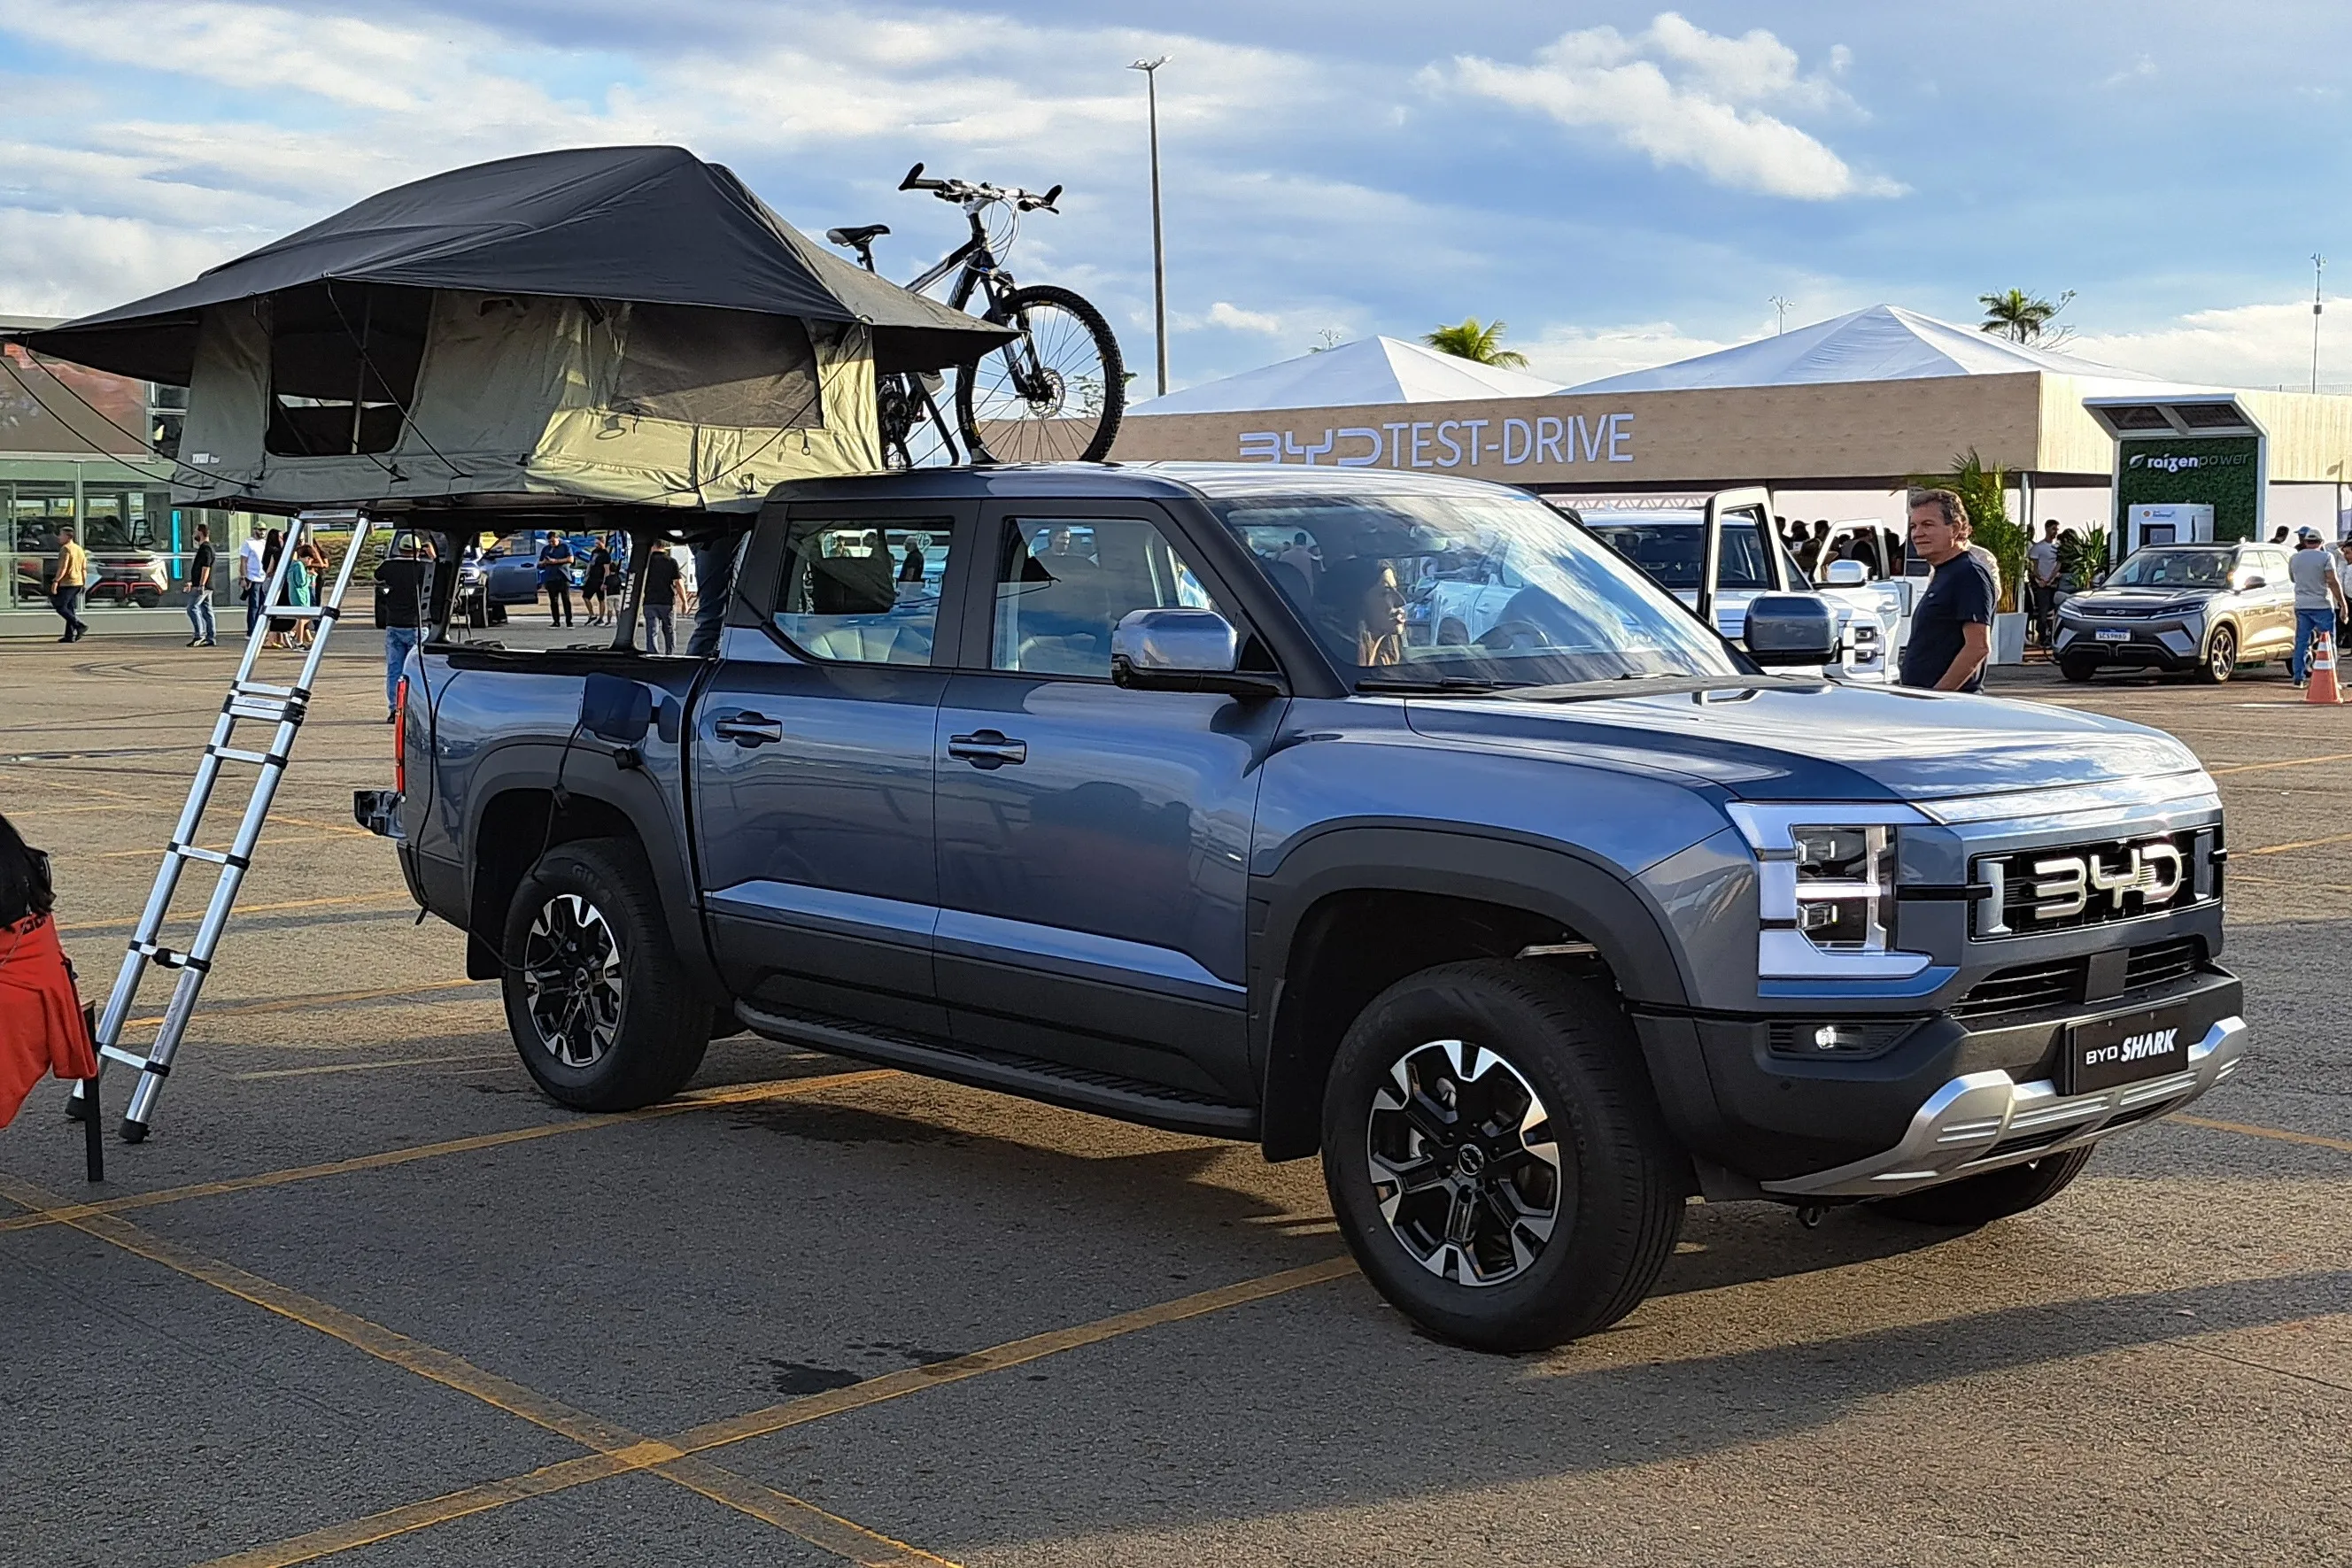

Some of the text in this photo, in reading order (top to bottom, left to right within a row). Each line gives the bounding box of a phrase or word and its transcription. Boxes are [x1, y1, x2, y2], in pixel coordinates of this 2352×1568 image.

[1239, 413, 1635, 467] BYD TEST-DRIVE
[2034, 844, 2183, 920] BYD
[2085, 1028, 2178, 1064] BYD SHARK
